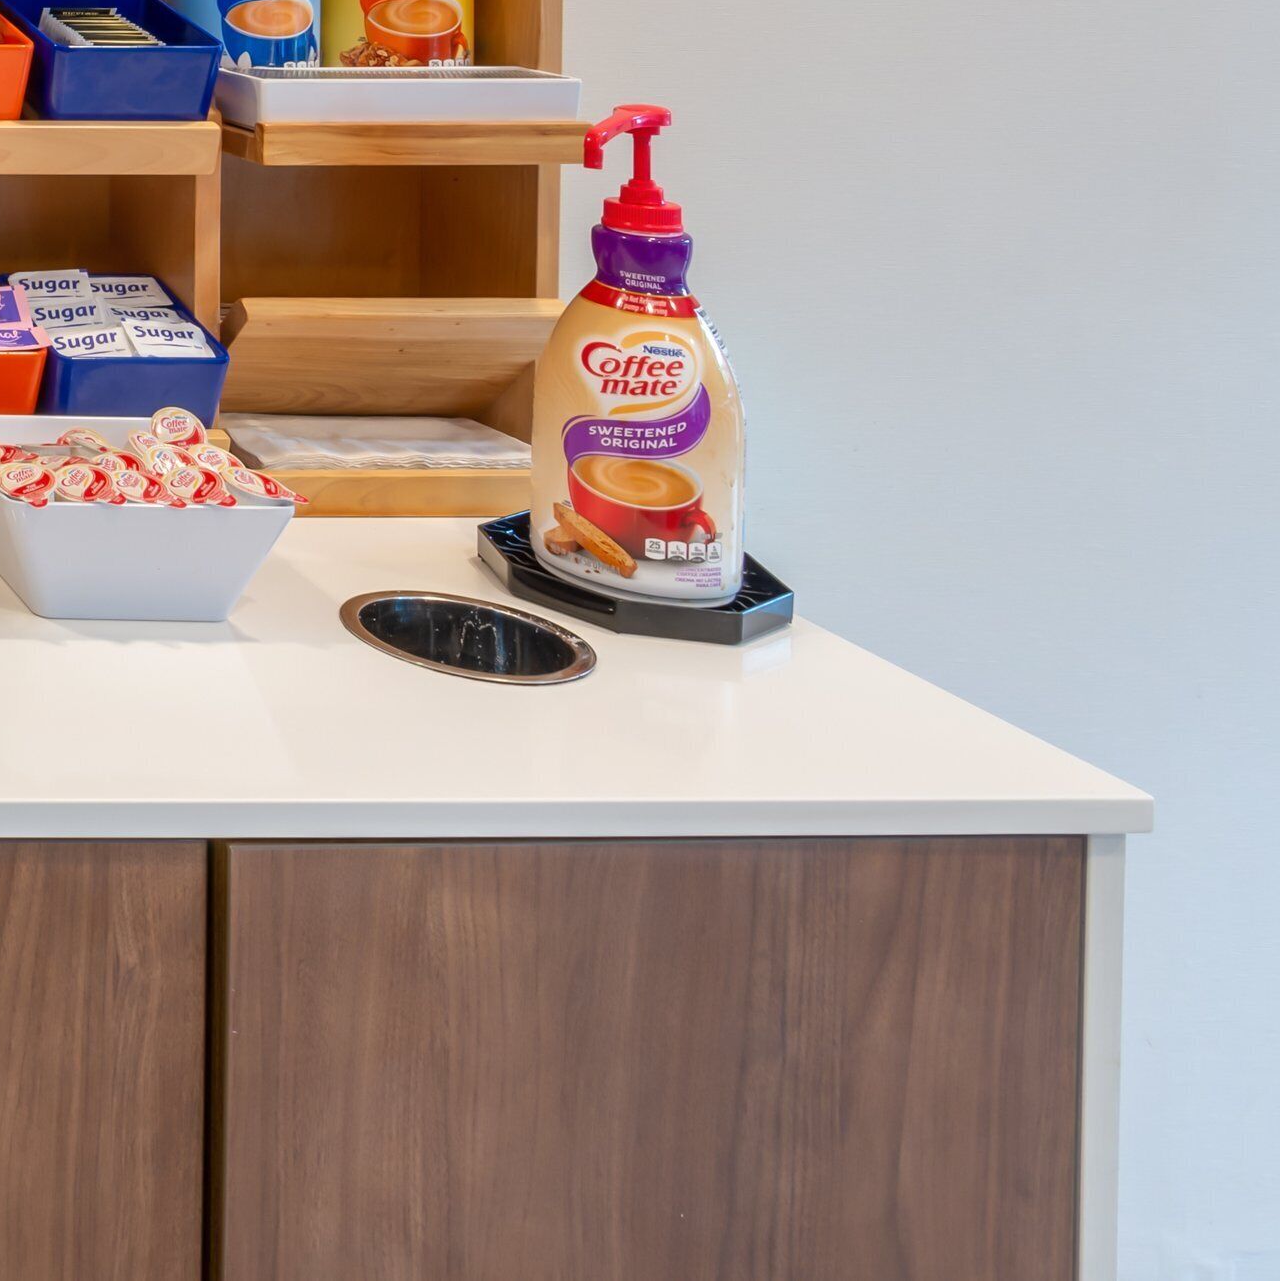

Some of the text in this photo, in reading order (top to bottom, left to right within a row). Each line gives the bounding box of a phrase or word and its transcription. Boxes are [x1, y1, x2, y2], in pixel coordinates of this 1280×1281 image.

[620, 271, 666, 283] SWEETENED
[19, 279, 80, 293] Sugar
[90, 282, 149, 296] Sugar
[625, 280, 662, 290] ORIGINAL
[34, 304, 97, 323] Sugar
[110, 307, 170, 320] Sugar
[53, 329, 117, 351] Sugar
[133, 325, 194, 342] Sugar
[581, 342, 684, 378] Coffee
[600, 379, 677, 396] mate
[589, 422, 688, 438] SWEETENED
[601, 438, 678, 450] ORIGINAL
[649, 541, 661, 549] 25
